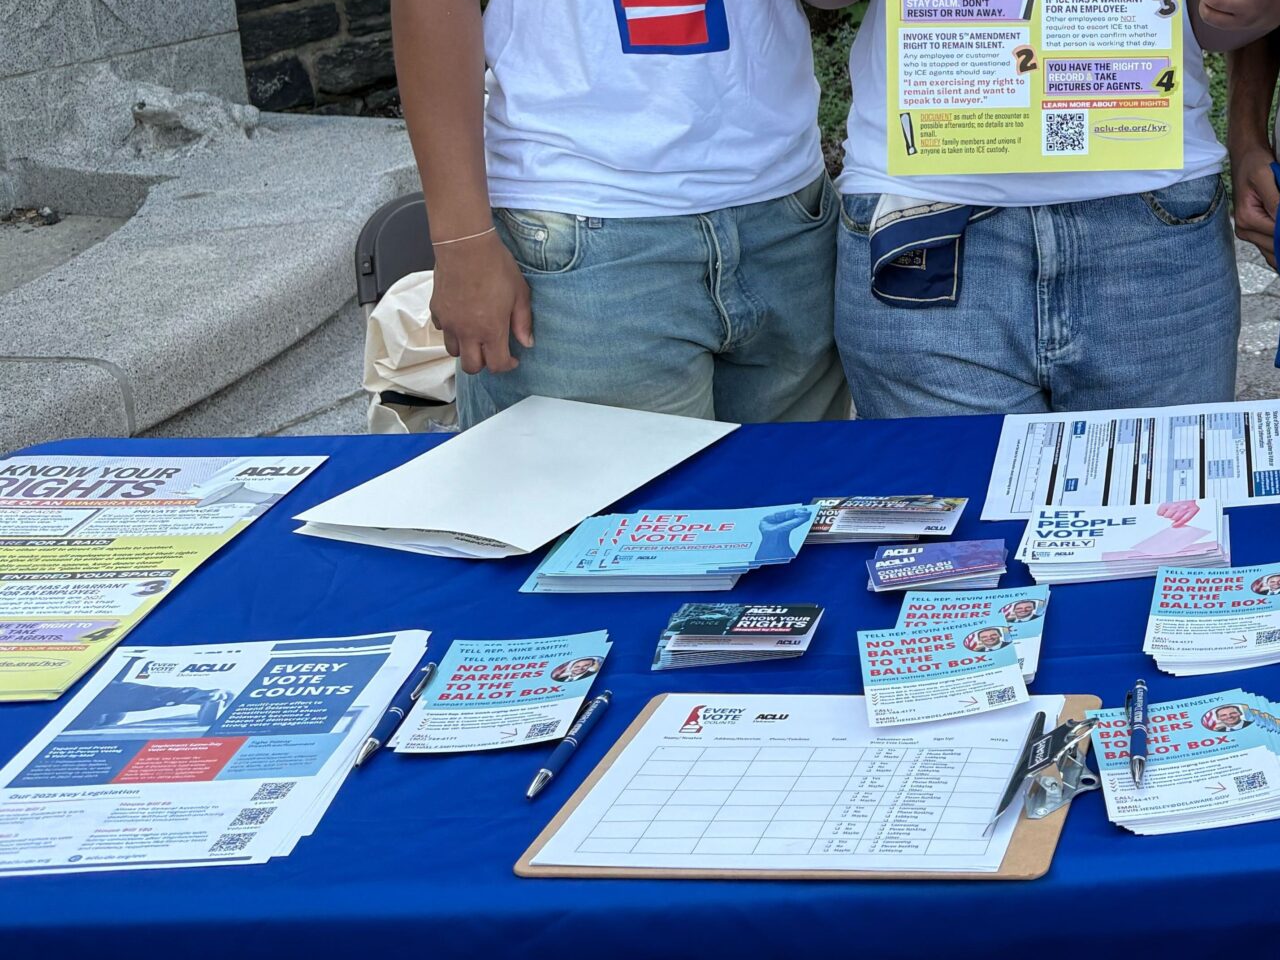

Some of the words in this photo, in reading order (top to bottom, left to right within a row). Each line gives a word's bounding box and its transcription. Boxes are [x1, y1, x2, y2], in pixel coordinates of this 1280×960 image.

[907, 0, 931, 7] STAY
[932, 0, 960, 7] CALM.
[962, 0, 990, 7] DON'T
[907, 9, 938, 17] RESIST
[940, 9, 953, 17] OR
[955, 9, 974, 17] RUN
[976, 9, 1005, 17] AWAY.
[1046, 5, 1061, 13] FOR
[1063, 5, 1076, 13] AN
[1079, 5, 1128, 13] EMPLOYEE:
[969, 32, 1020, 40] AMENDMENT
[1016, 50, 1037, 73] 2
[1048, 63, 1064, 71] YOU
[1067, 62, 1093, 71] HAVE
[1095, 62, 1110, 70] THE
[1113, 62, 1138, 70] RIGHT
[1141, 62, 1152, 70] TO
[1048, 73, 1084, 81] RECORD
[1095, 72, 1117, 81] TAKE
[1156, 70, 1175, 92] 4
[1048, 82, 1090, 91] PICTURES
[1093, 82, 1106, 91] OF
[1108, 82, 1143, 90] AGENTS.
[0, 465, 98, 478] KNOW
[99, 467, 181, 479] YOUR
[235, 467, 311, 477] ACLU
[641, 514, 689, 523] LET
[1040, 510, 1086, 519] LET
[633, 523, 735, 532] PEOPLE
[1037, 517, 1137, 529] PEOPLE
[628, 533, 698, 542] VOTE
[1036, 528, 1105, 538] VOTE
[661, 542, 750, 551] INCARCERATION
[1037, 540, 1093, 548] EARLY
[180, 662, 237, 672] ACLU
[269, 663, 348, 674] EVERY
[262, 675, 326, 685] VOTE
[249, 685, 353, 698] COUNTS
[704, 707, 747, 715] EVERY
